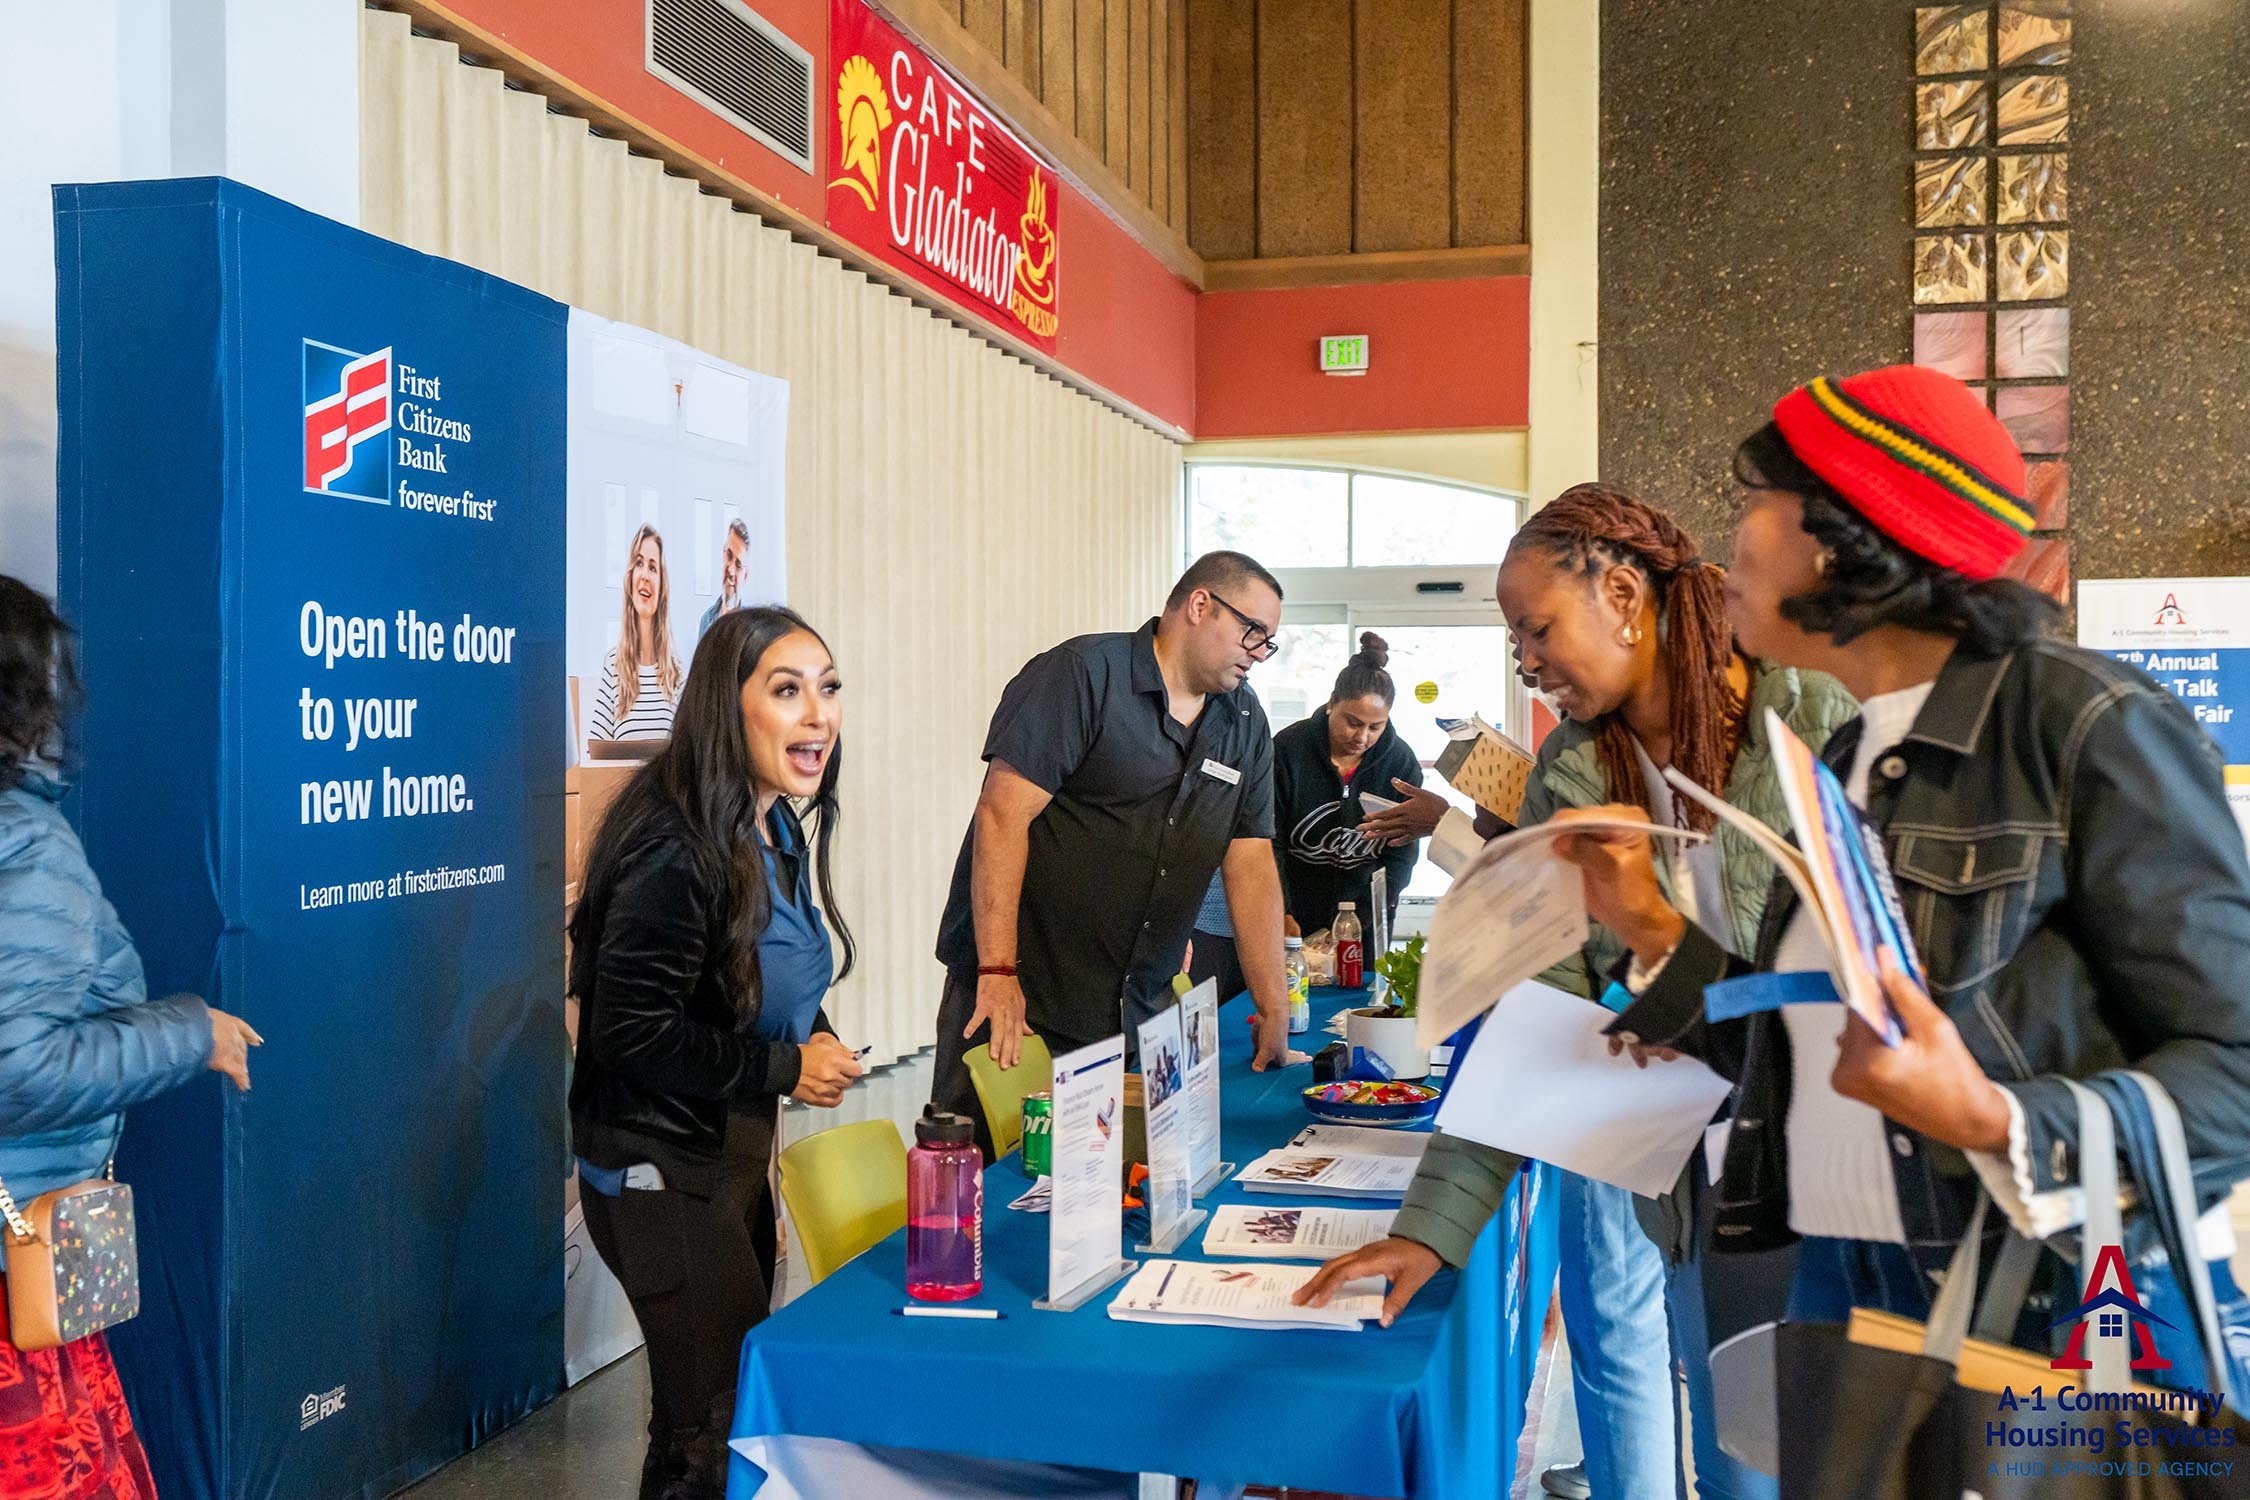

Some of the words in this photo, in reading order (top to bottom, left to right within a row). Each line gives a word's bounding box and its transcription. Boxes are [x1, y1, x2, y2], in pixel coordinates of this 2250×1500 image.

[890, 50, 985, 173] CAFE
[889, 120, 1022, 309] Gladiator
[1011, 289, 1058, 337] ESPRESSO
[1326, 339, 1363, 367] EXIT
[398, 365, 441, 401] First
[398, 402, 471, 443] Citizens
[398, 437, 447, 474] Bank
[398, 479, 460, 516] forever
[300, 601, 386, 669] Open
[396, 609, 444, 662] the
[453, 614, 516, 663] door
[2146, 652, 2219, 671] Annual
[2173, 678, 2219, 697] Talk
[299, 688, 334, 740] to
[345, 698, 417, 751] your
[2194, 704, 2233, 723] Fair
[301, 778, 373, 825] new
[383, 766, 473, 817] home.
[301, 884, 343, 910] Learn
[347, 879, 384, 903] more
[388, 873, 402, 897] at
[405, 864, 505, 895] firstcitizens.com
[974, 1190, 982, 1281] Columbia
[320, 1392, 346, 1420] FDIC
